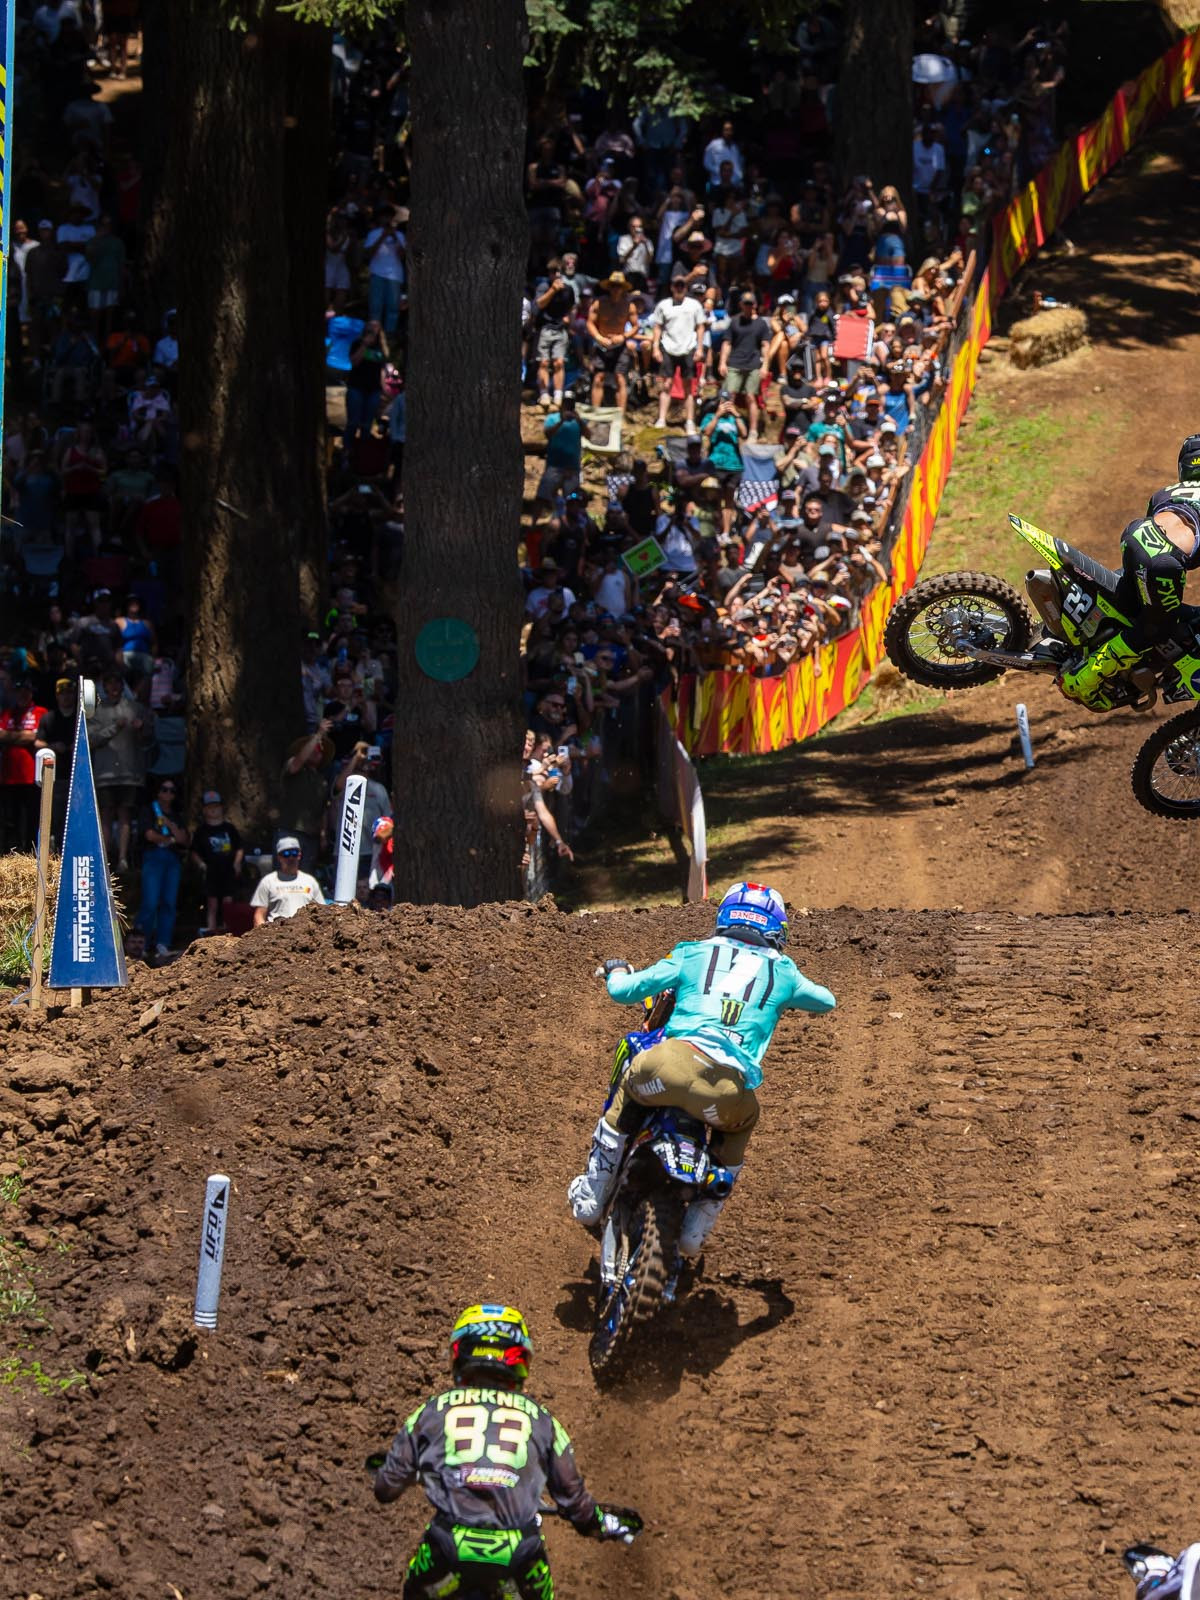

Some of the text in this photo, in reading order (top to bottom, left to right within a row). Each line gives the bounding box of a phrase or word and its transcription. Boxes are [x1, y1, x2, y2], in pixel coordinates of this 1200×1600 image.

[342, 804, 355, 852] UFO
[78, 855, 90, 962] MOTOCROSS
[730, 910, 769, 926] DANGER
[205, 1208, 218, 1260] UFO
[437, 1388, 539, 1420] FORKNER
[444, 1404, 532, 1470] 83
